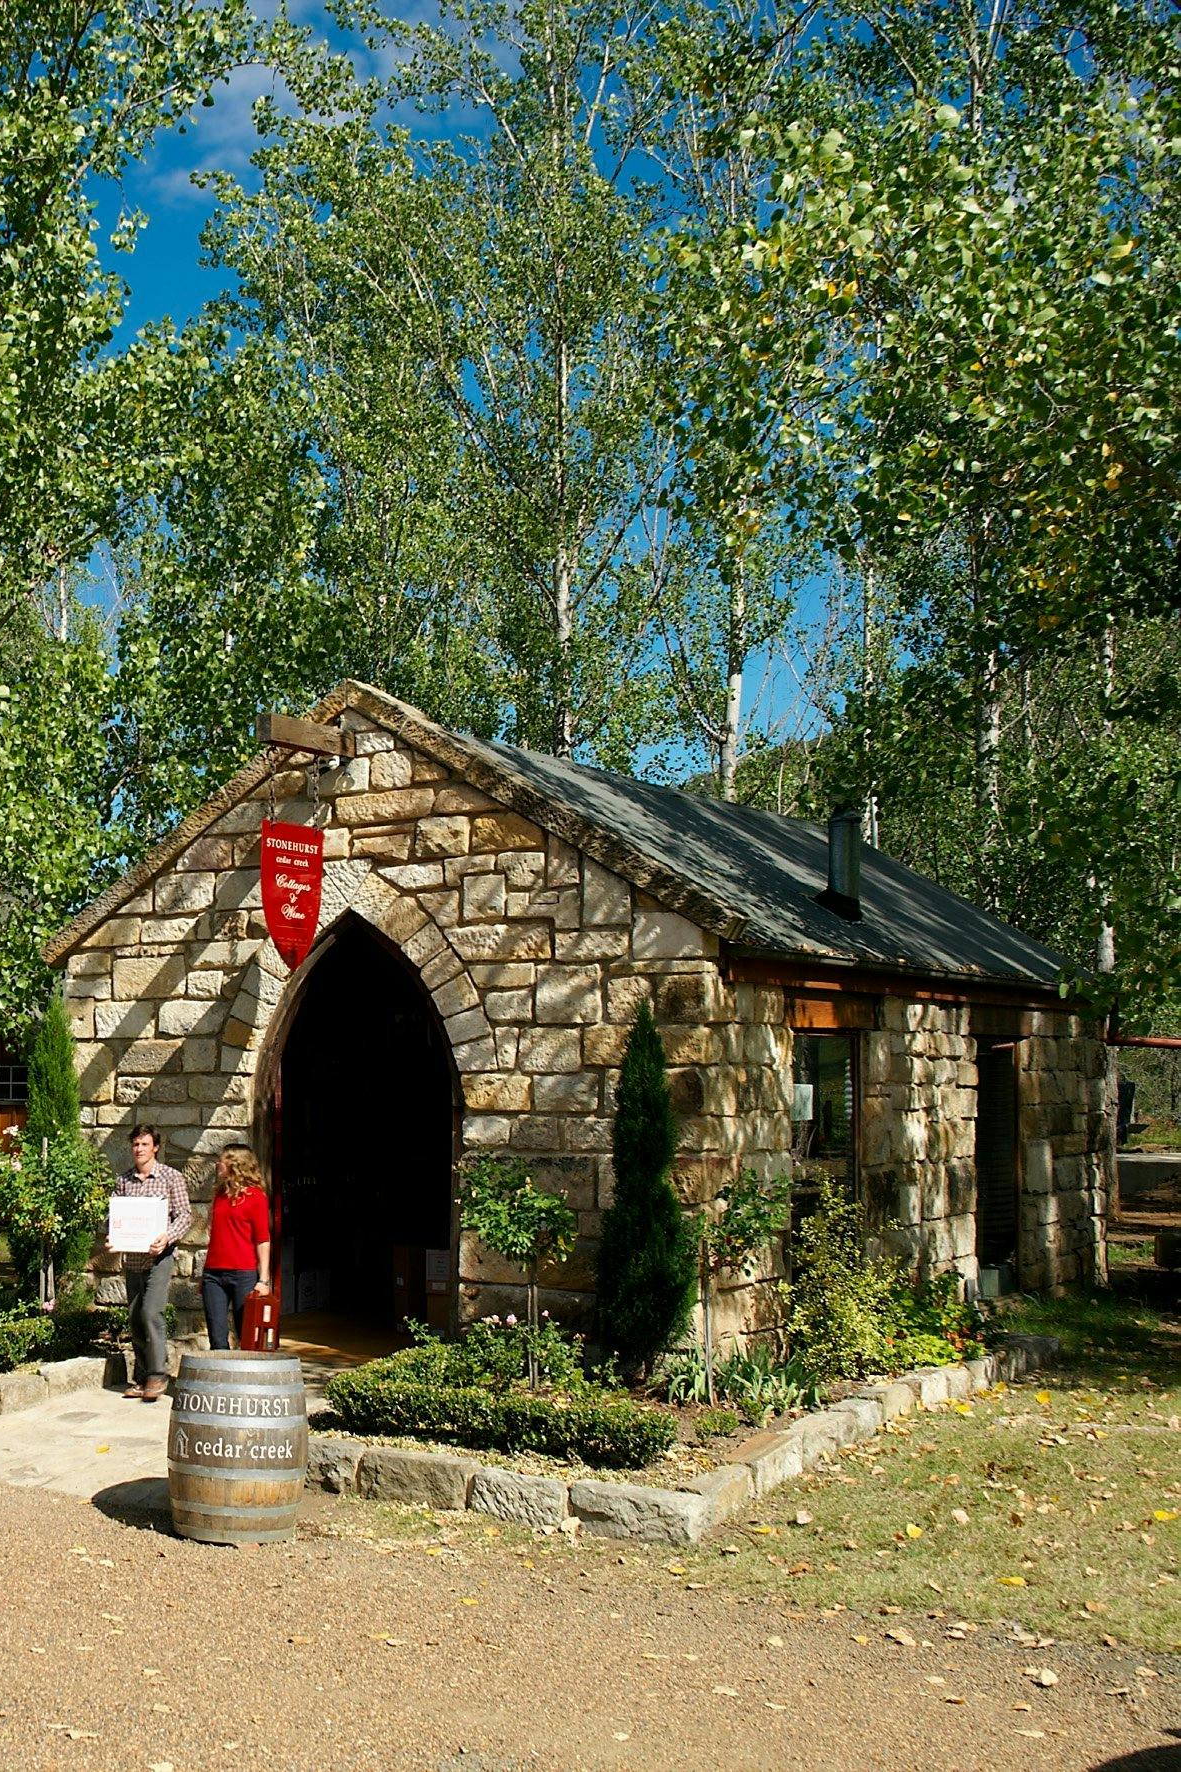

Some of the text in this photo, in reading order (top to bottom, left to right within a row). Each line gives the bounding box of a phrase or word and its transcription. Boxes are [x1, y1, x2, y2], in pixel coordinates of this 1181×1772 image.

[266, 837, 319, 854] STONEHURST
[276, 855, 309, 867] cedar creek
[281, 903, 306, 920] Wine
[177, 1392, 290, 1416] STONEHURST
[195, 1438, 293, 1459] cedar creek
